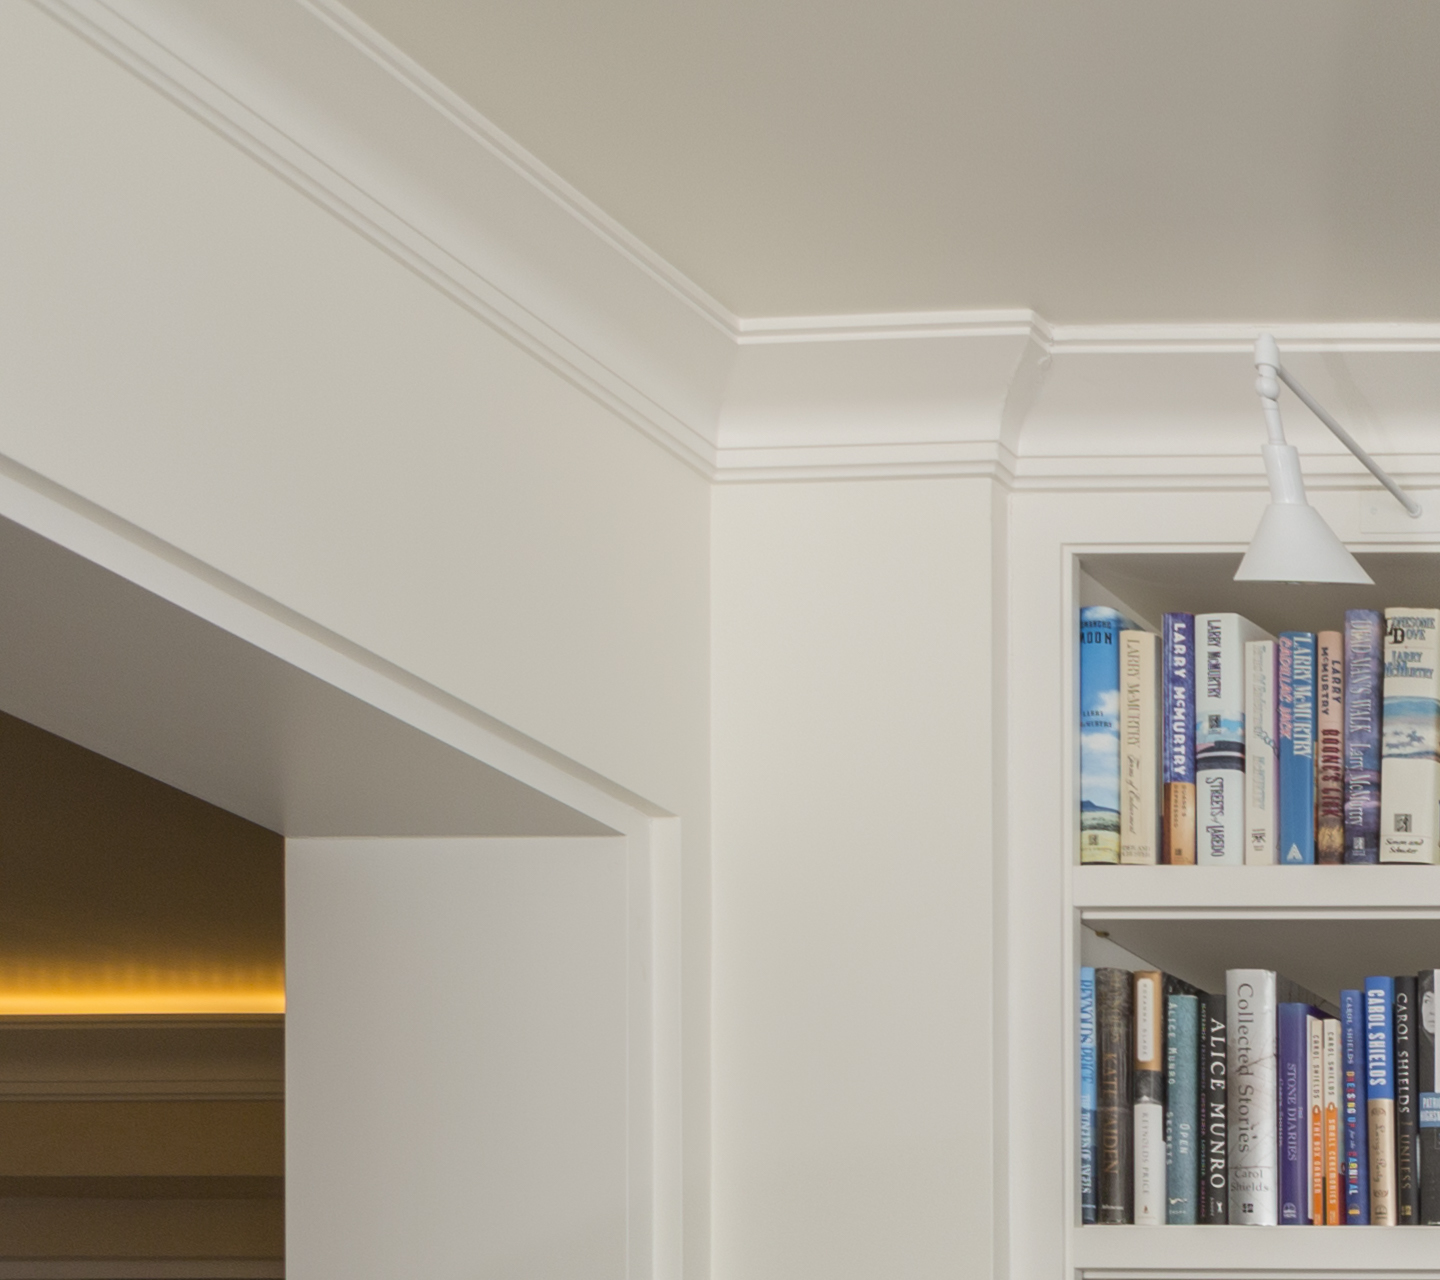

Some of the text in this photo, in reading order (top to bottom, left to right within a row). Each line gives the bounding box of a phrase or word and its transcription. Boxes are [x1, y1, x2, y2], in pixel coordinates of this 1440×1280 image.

[1172, 623, 1186, 775] LARRY McMURTRY
[1211, 1018, 1225, 1188] ALICE MUNRO
[1235, 983, 1254, 1153] Collected Stories
[1368, 990, 1387, 1085] CAROL SHIELDS
